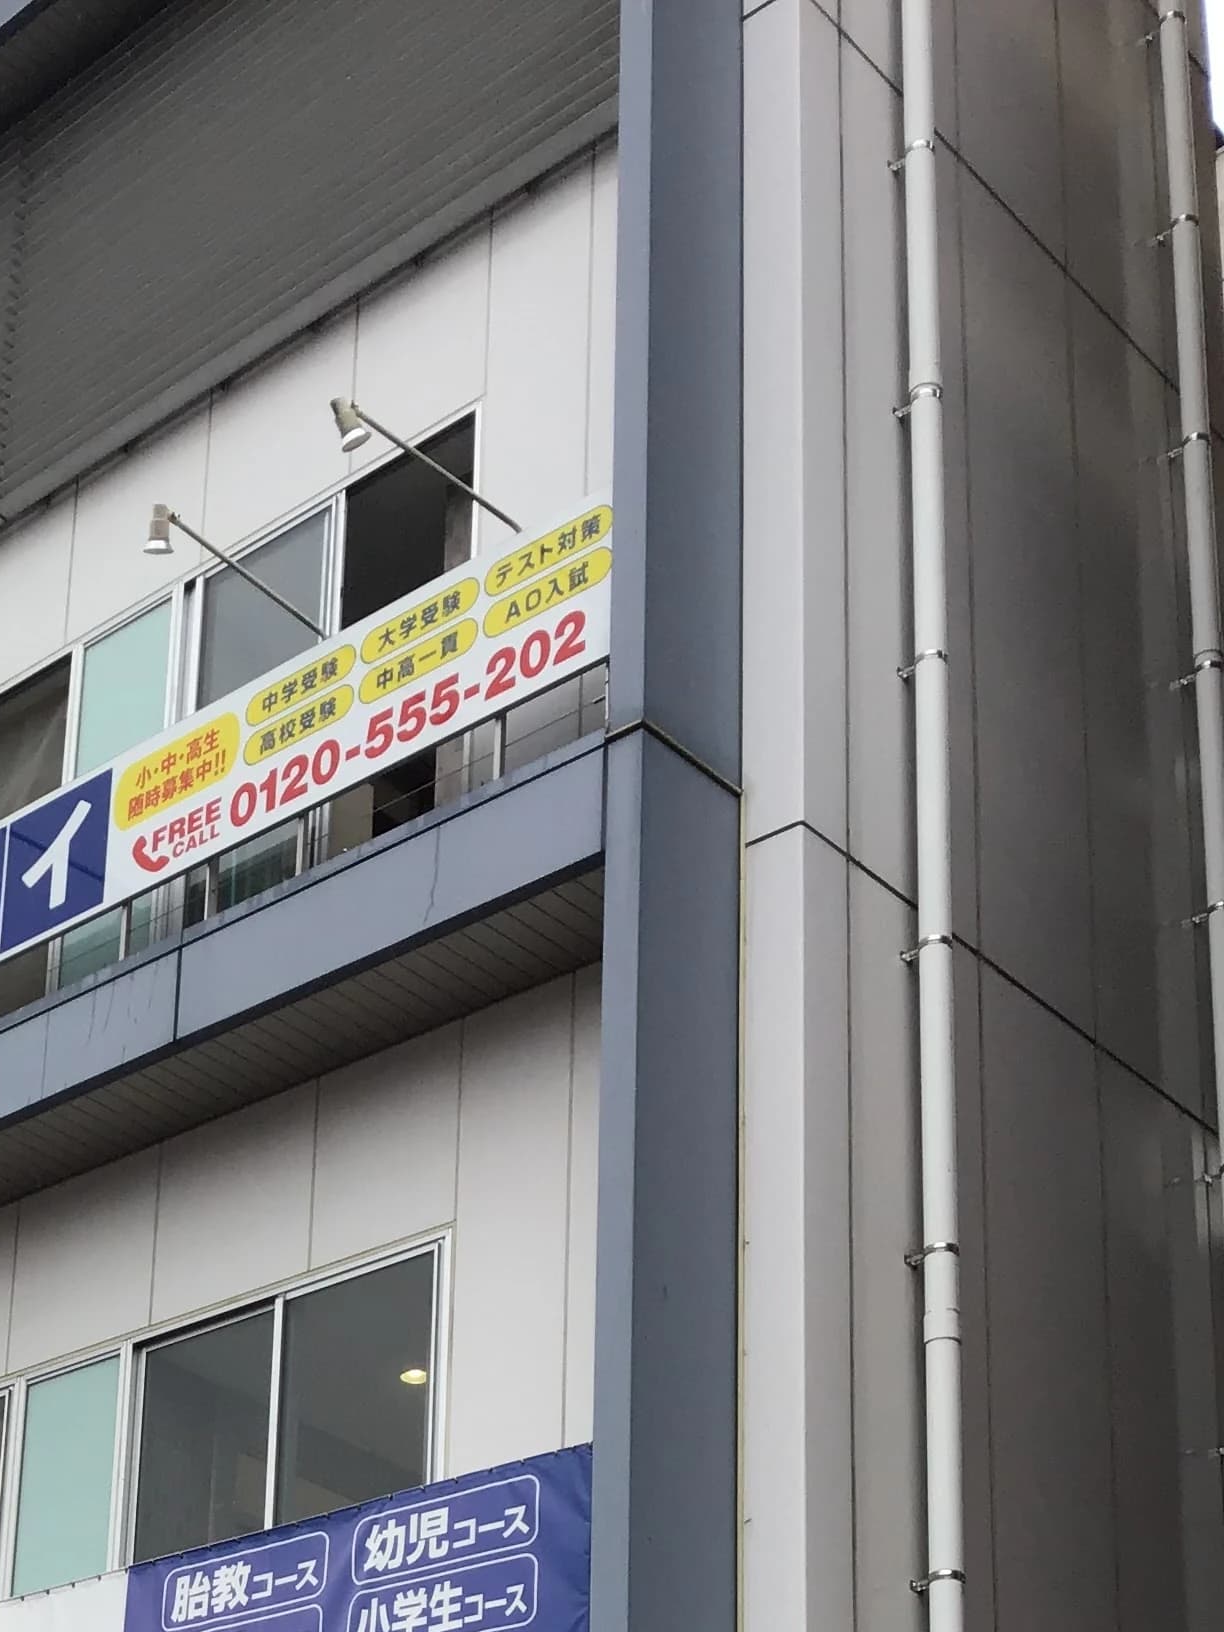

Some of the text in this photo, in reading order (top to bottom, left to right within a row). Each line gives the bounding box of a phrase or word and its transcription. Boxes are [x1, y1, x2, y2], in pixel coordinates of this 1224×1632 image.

[494, 511, 602, 589] テスト対策
[378, 589, 463, 652] 大学受験
[505, 560, 591, 622] AO入試
[262, 655, 340, 713] 中学受験
[376, 630, 461, 692] 中高一貫
[229, 610, 588, 828] 0120-555-202
[259, 695, 338, 756] 高校受験
[151, 797, 223, 851] FREE
[171, 827, 221, 858] CALL
[364, 1502, 531, 1572] 幼児コース
[172, 1557, 319, 1622] 胎教コース
